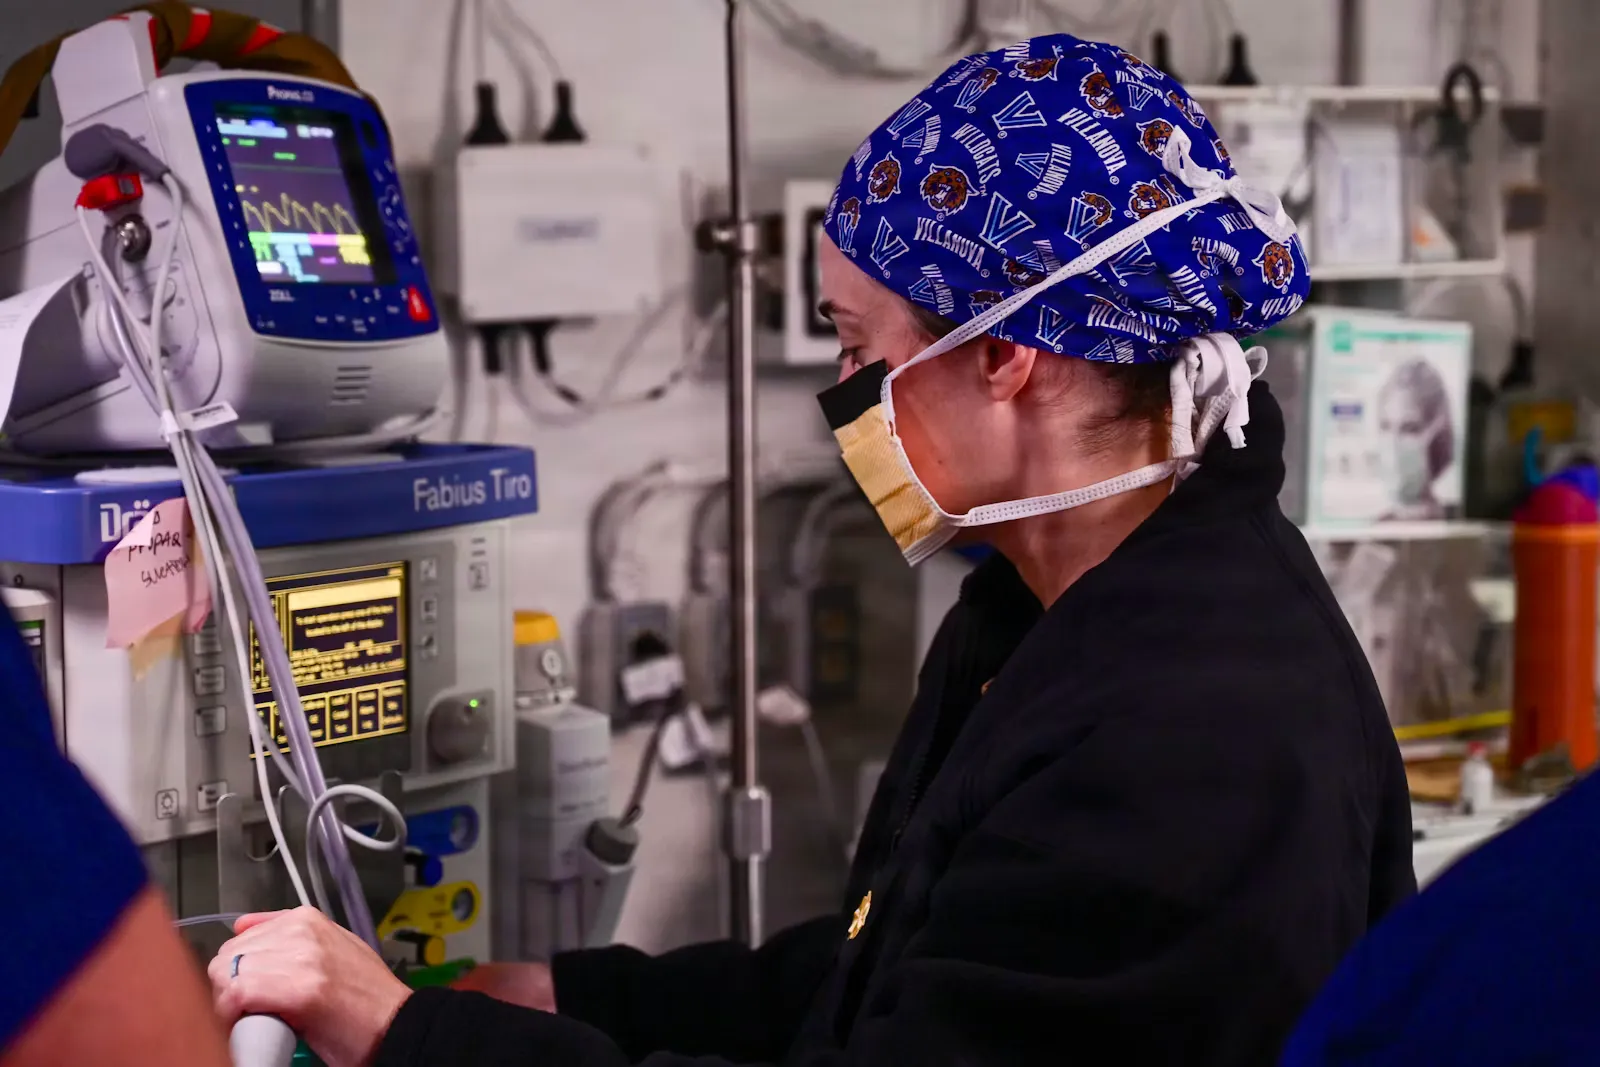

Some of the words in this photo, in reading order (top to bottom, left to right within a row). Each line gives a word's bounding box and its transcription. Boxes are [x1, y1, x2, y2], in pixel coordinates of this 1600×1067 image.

[918, 114, 942, 156] VILLANOVA
[951, 123, 1001, 184] WILDCATS
[1057, 107, 1127, 175] VILLANOVA
[1032, 143, 1072, 194] VILLANOVA
[914, 216, 985, 271] VILLANOVA
[414, 474, 486, 511] Fabius
[489, 468, 532, 501] Tiro
